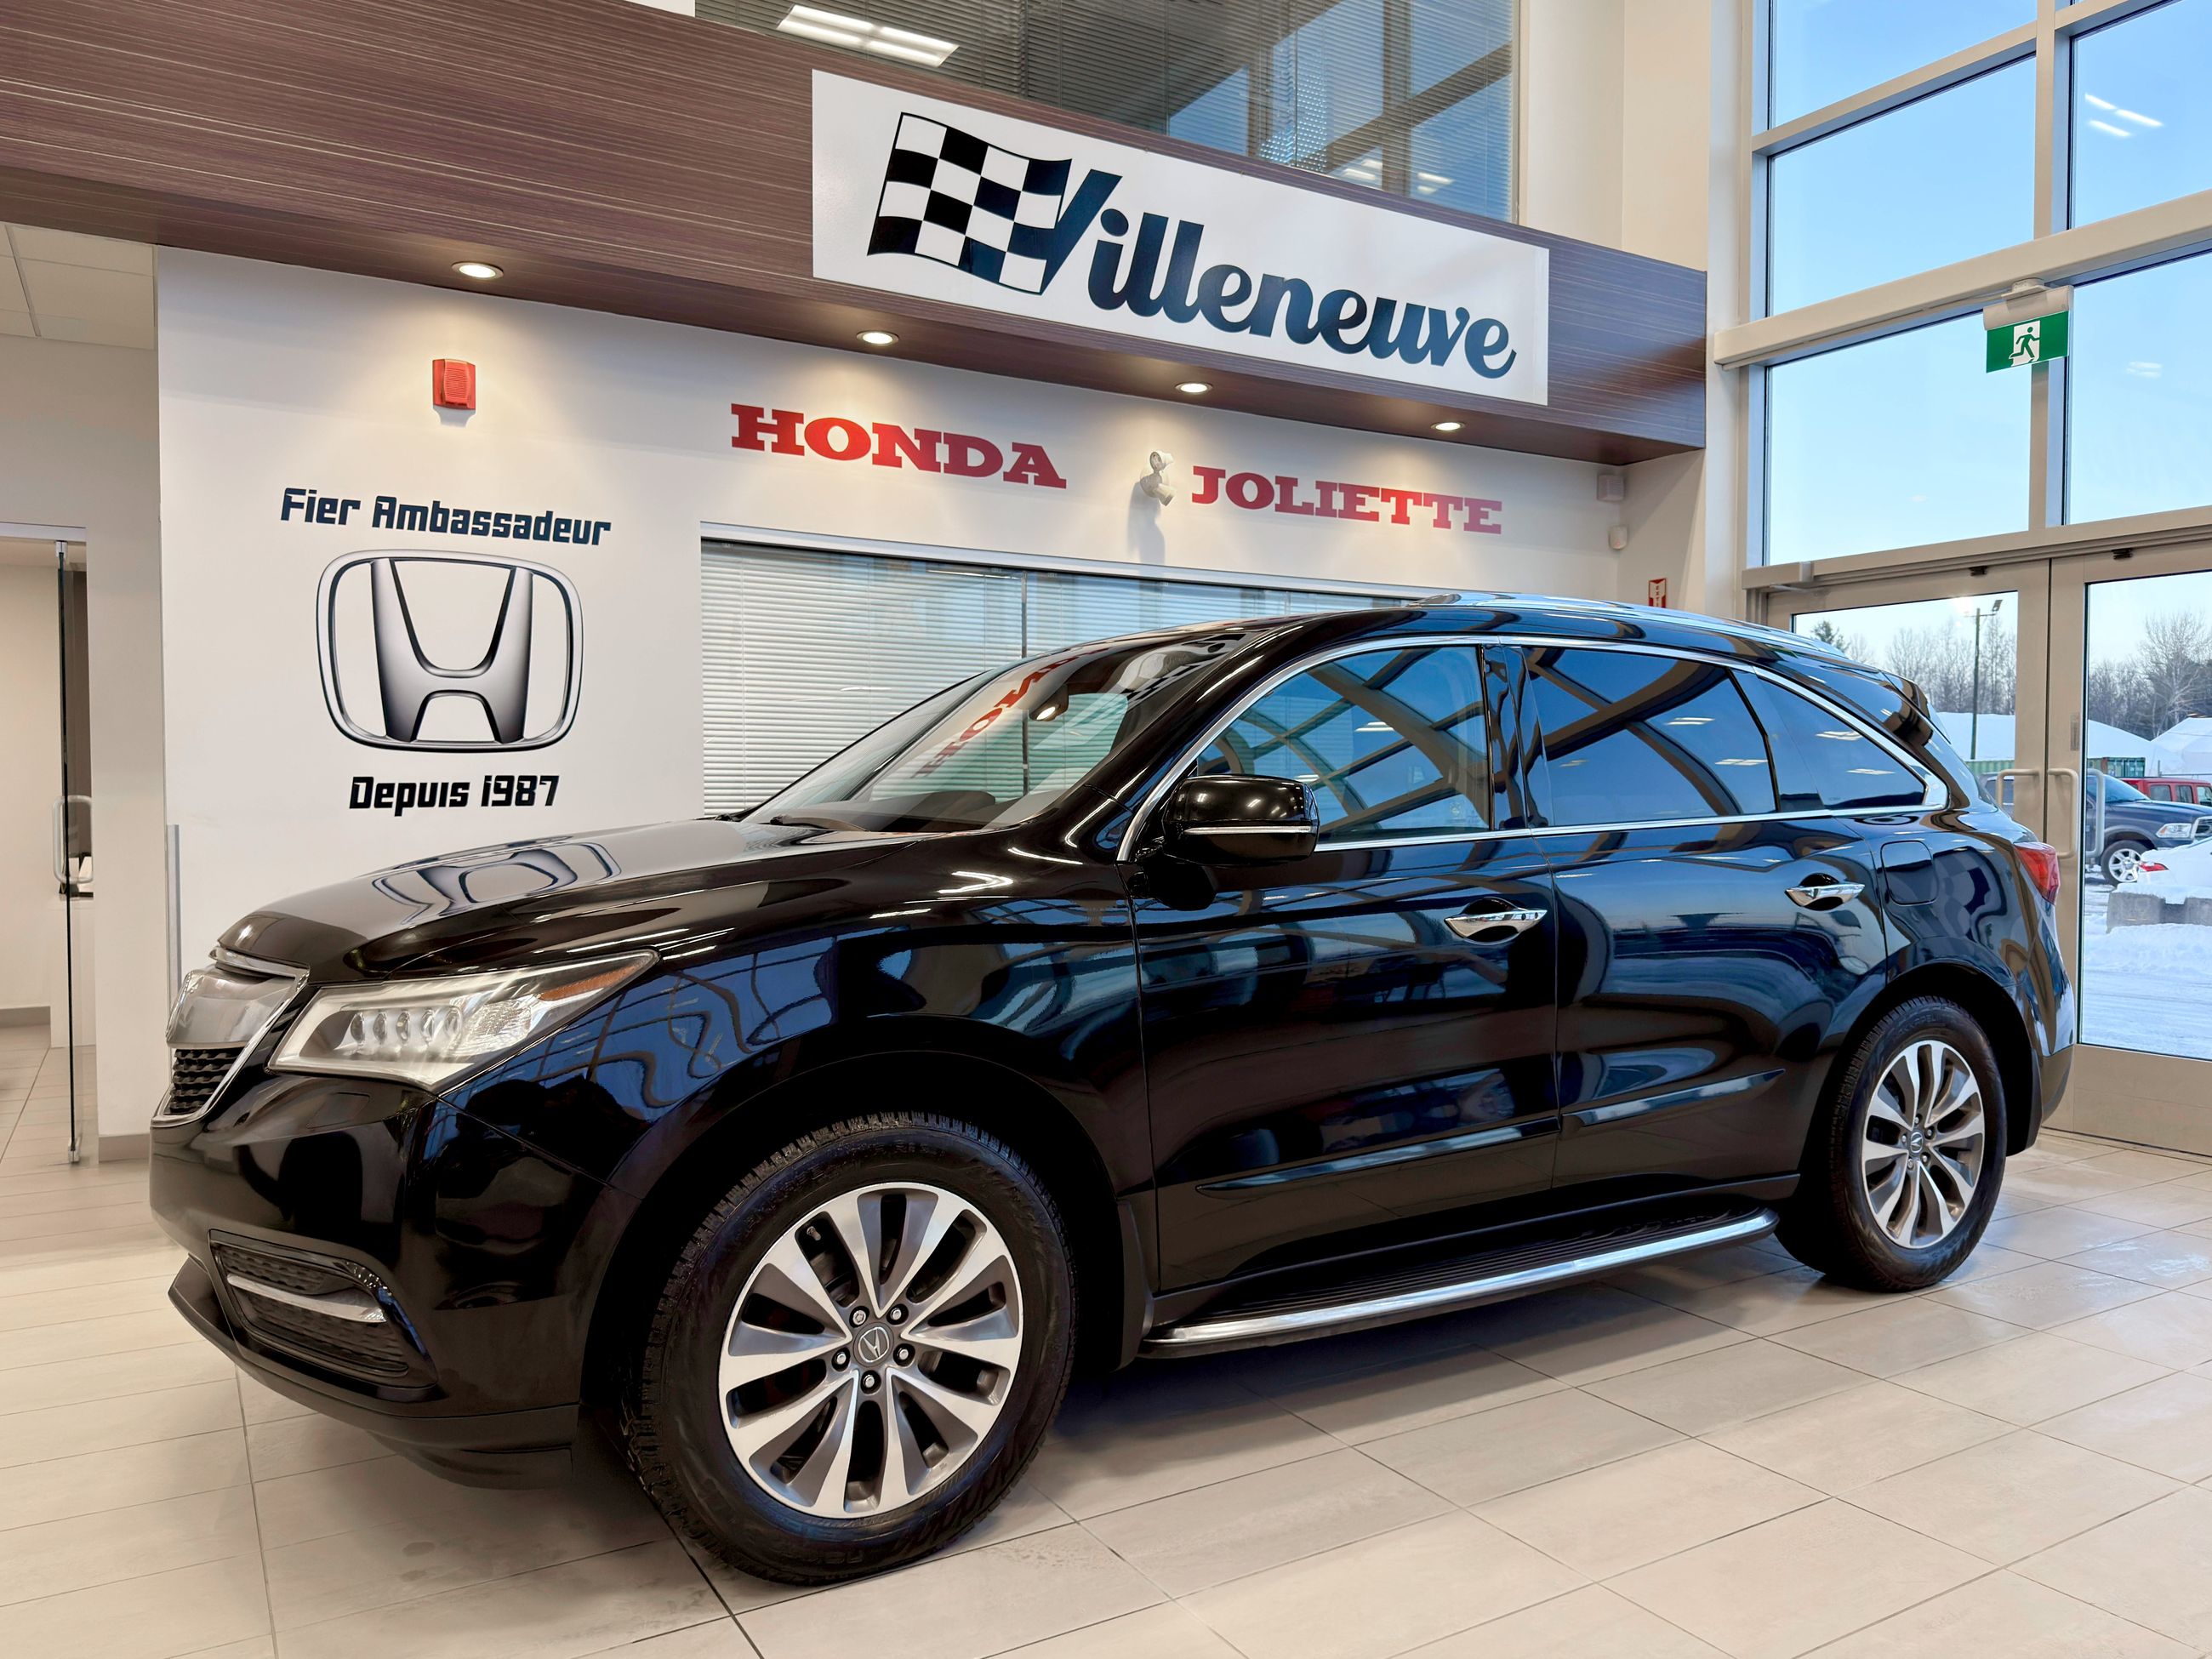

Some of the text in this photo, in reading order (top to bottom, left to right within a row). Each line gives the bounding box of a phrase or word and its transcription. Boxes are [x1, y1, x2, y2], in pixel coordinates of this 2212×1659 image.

[1038, 168, 1518, 379] Villeneuve
[280, 487, 613, 546] Fier Ambassadeur
[731, 404, 1503, 535] HONDA JOLIETTE
[349, 776, 470, 818] Depuis
